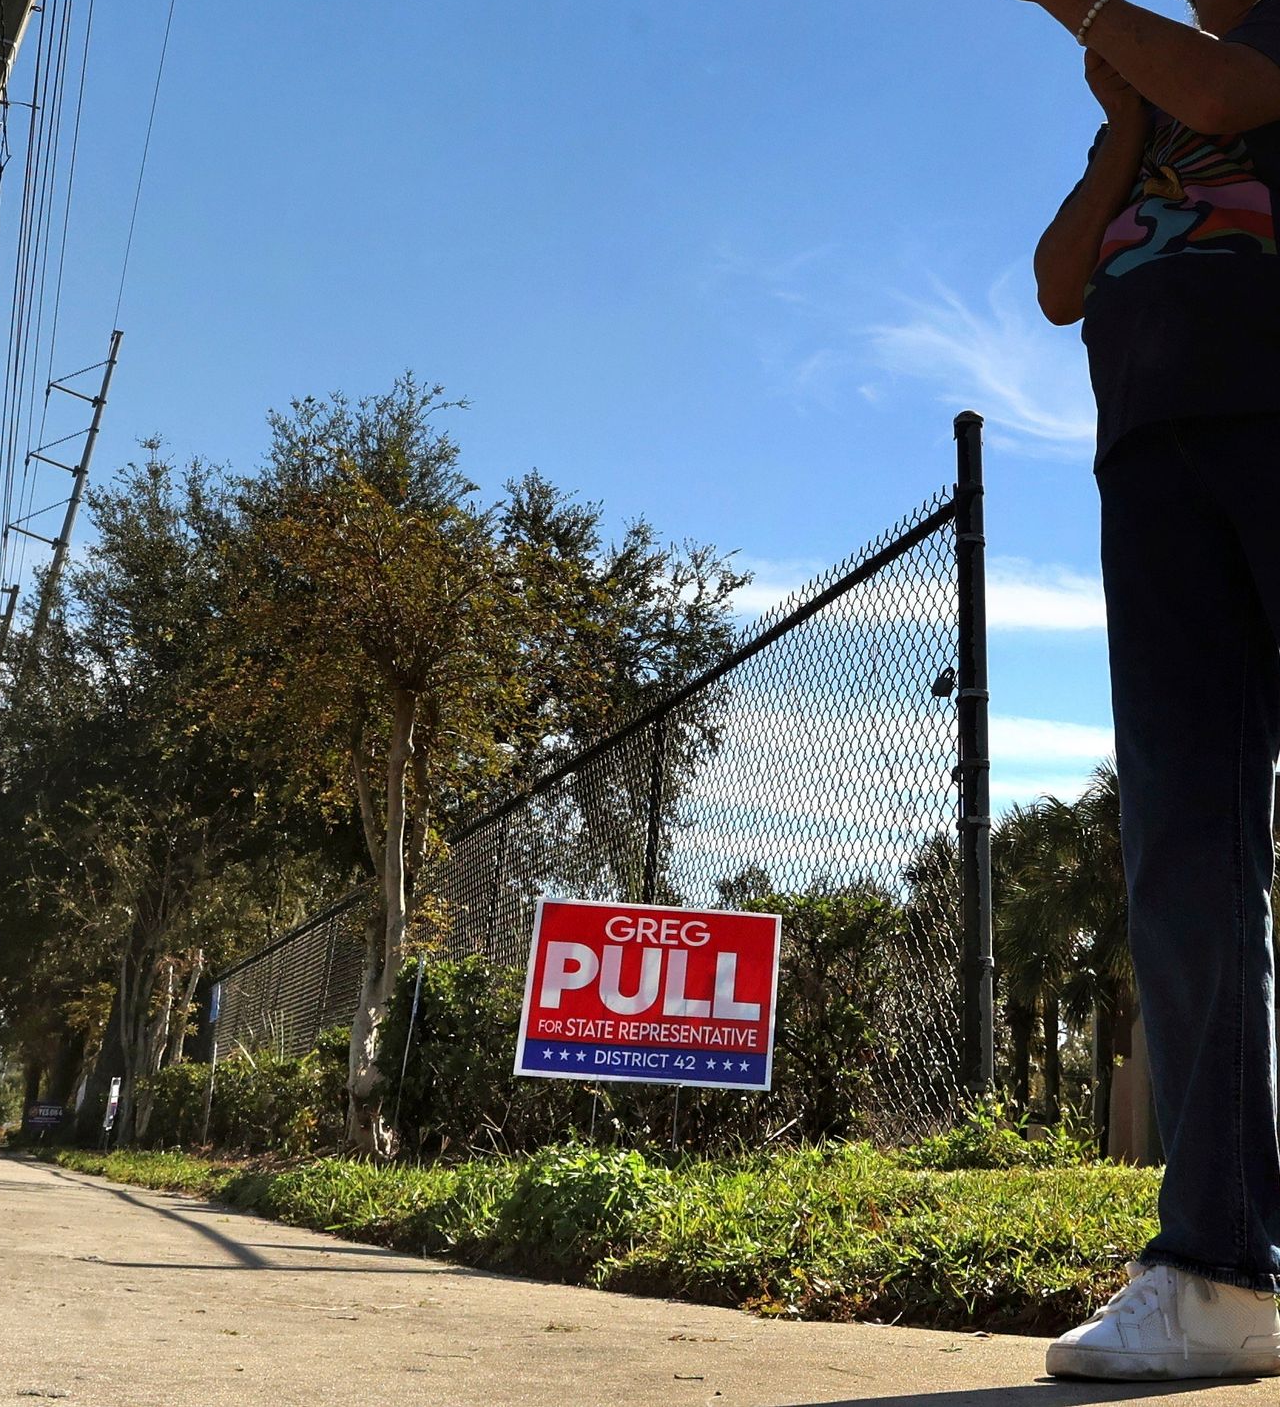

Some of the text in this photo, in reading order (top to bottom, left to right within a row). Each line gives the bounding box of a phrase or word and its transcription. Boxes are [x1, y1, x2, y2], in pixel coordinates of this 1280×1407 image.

[605, 916, 711, 946] GREG
[540, 940, 761, 1021] PULL
[538, 1018, 758, 1048] FOR STATE REPRESENTATIVE
[594, 1049, 696, 1070] DISTRICT 42
